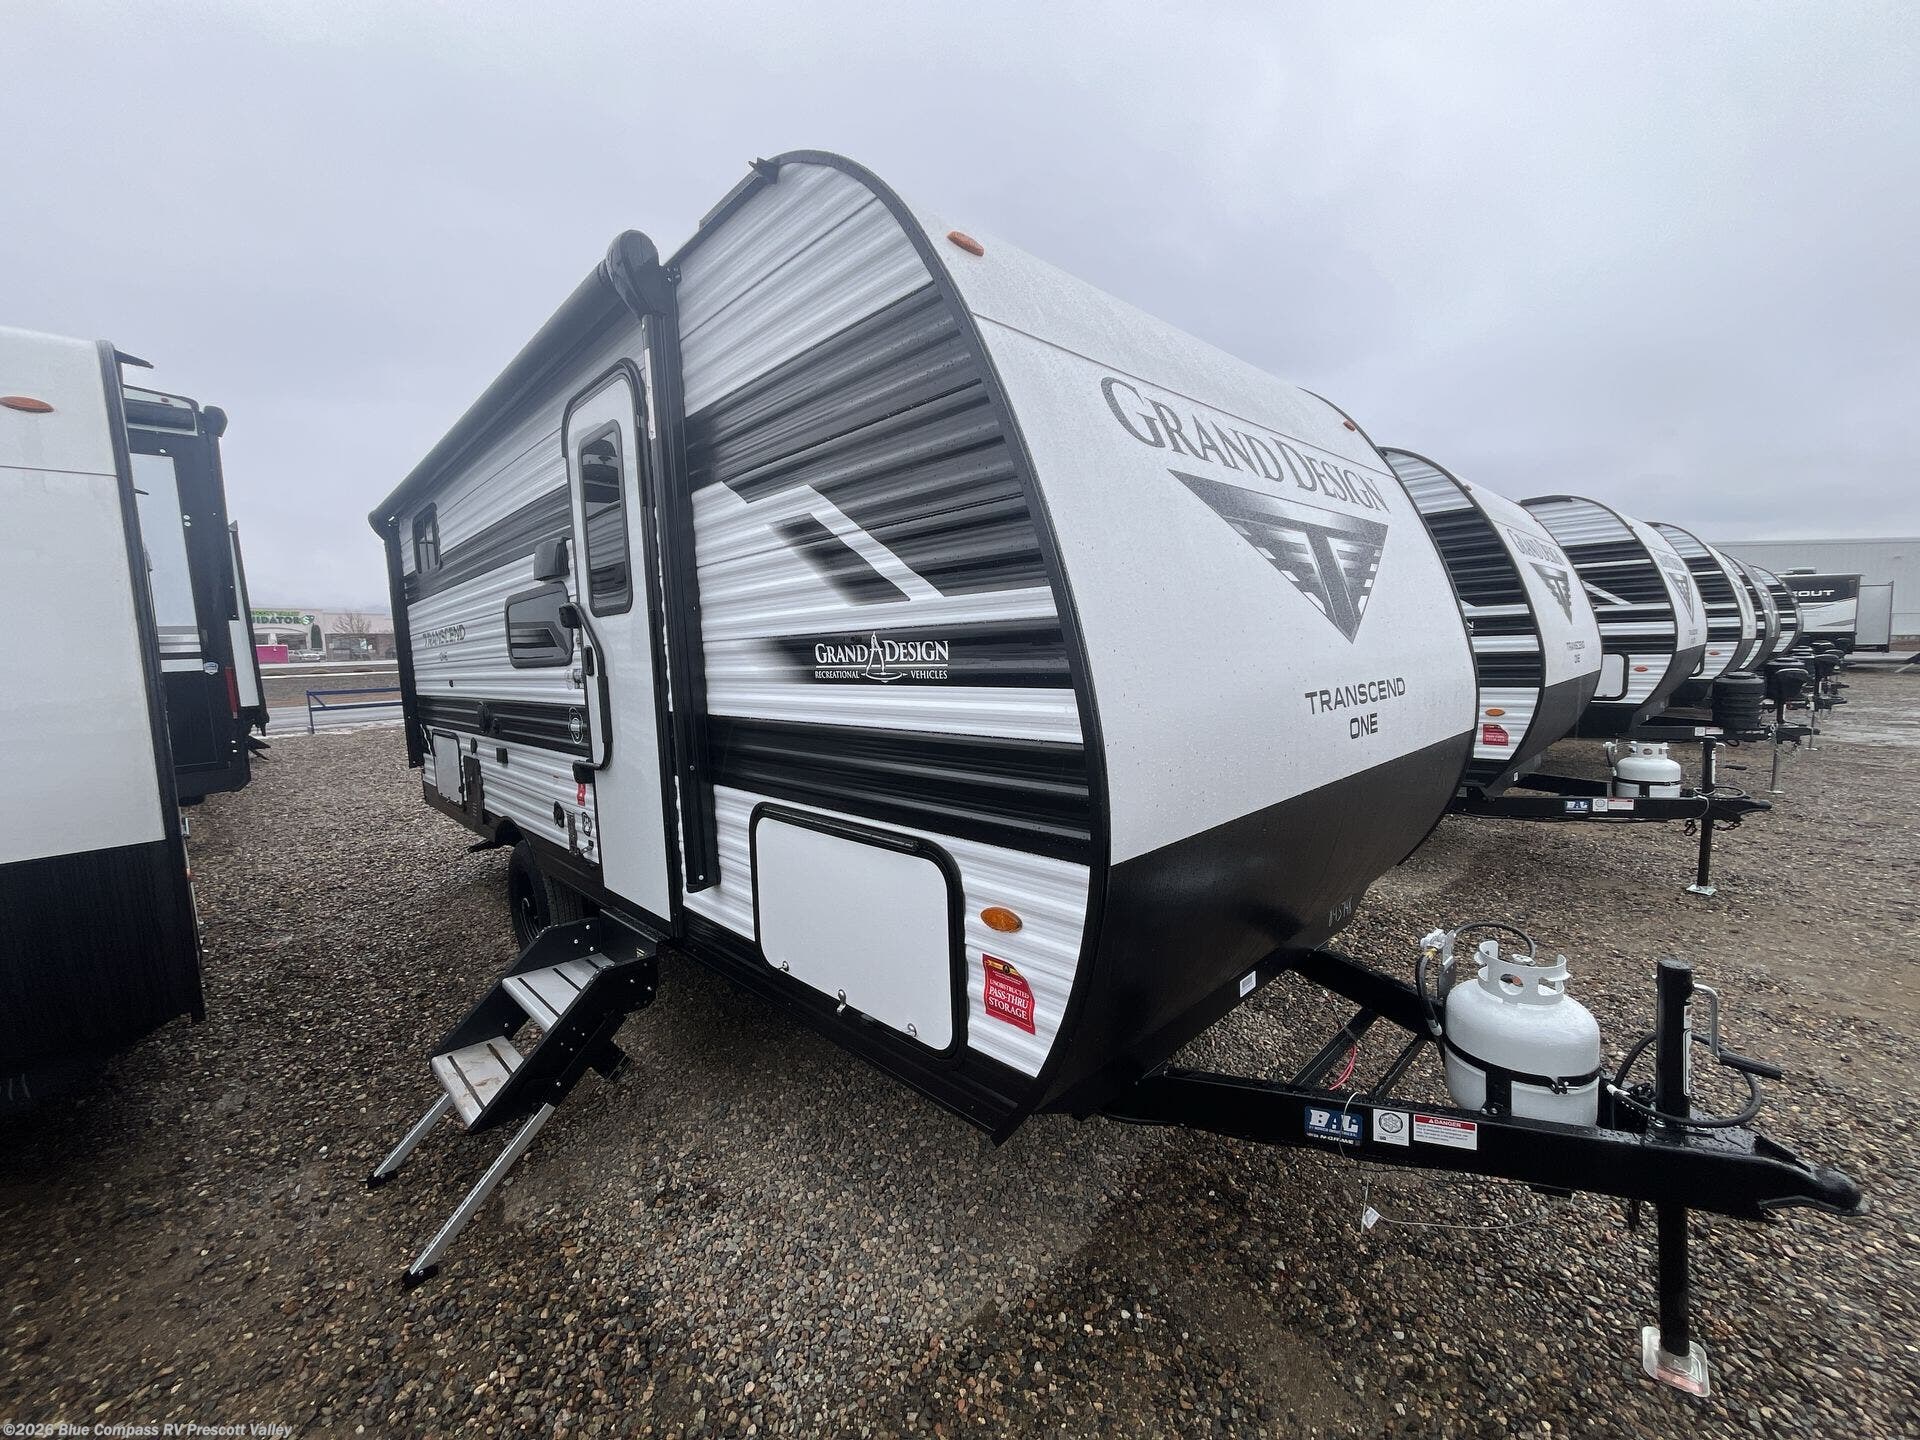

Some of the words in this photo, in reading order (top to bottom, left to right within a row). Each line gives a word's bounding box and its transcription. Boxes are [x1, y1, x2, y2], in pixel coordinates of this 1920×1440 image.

[1100, 376, 1285, 482] GRAND
[1270, 436, 1392, 514] DESIGN
[815, 643, 868, 663] GRAND
[882, 640, 949, 662] DESIGN
[814, 670, 860, 679] RECREATIONAL
[910, 670, 948, 680] VEHICLES
[1304, 677, 1406, 715] TRANSCEND
[1349, 712, 1378, 740] ONE
[988, 997, 1028, 1020] STORAGE
[989, 986, 1029, 1009] PASS-THRU
[1434, 1118, 1462, 1128] DANGER
